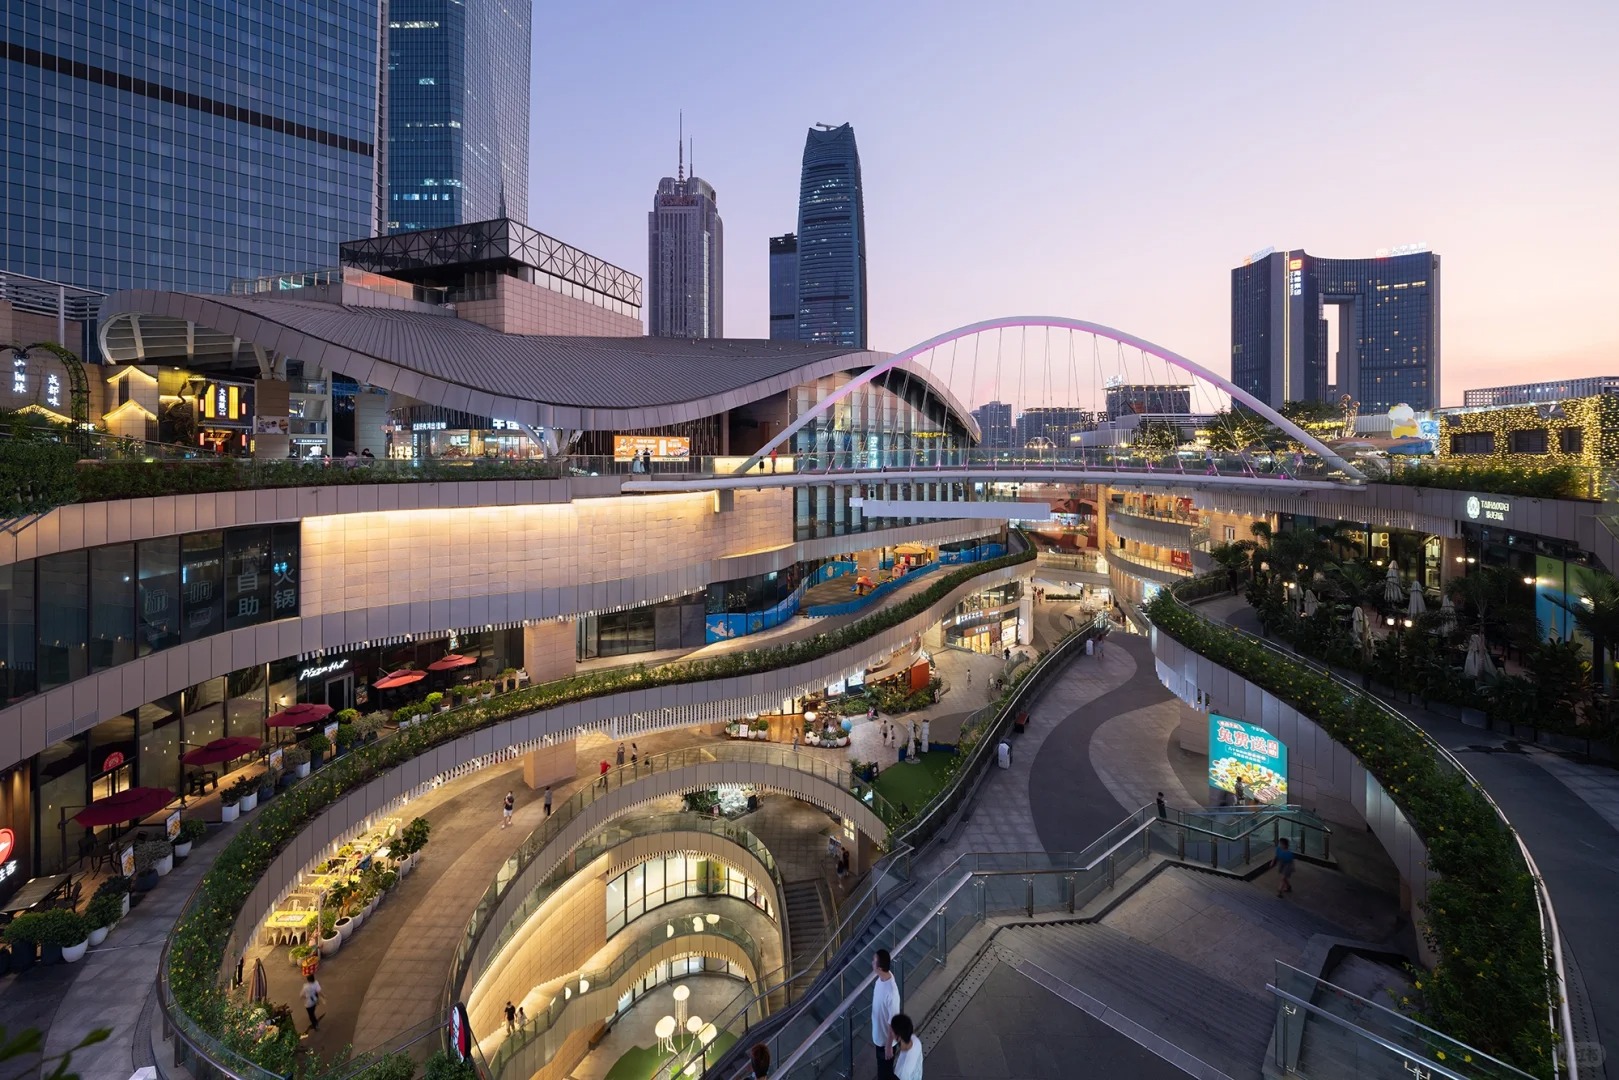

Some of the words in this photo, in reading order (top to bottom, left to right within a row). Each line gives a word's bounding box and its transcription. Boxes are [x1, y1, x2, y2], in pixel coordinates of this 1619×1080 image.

[47, 374, 61, 407] 成都味
[237, 571, 259, 617] 自助
[274, 567, 296, 609] 火锅
[299, 665, 328, 681] Pizza
[328, 658, 349, 673] Hut
